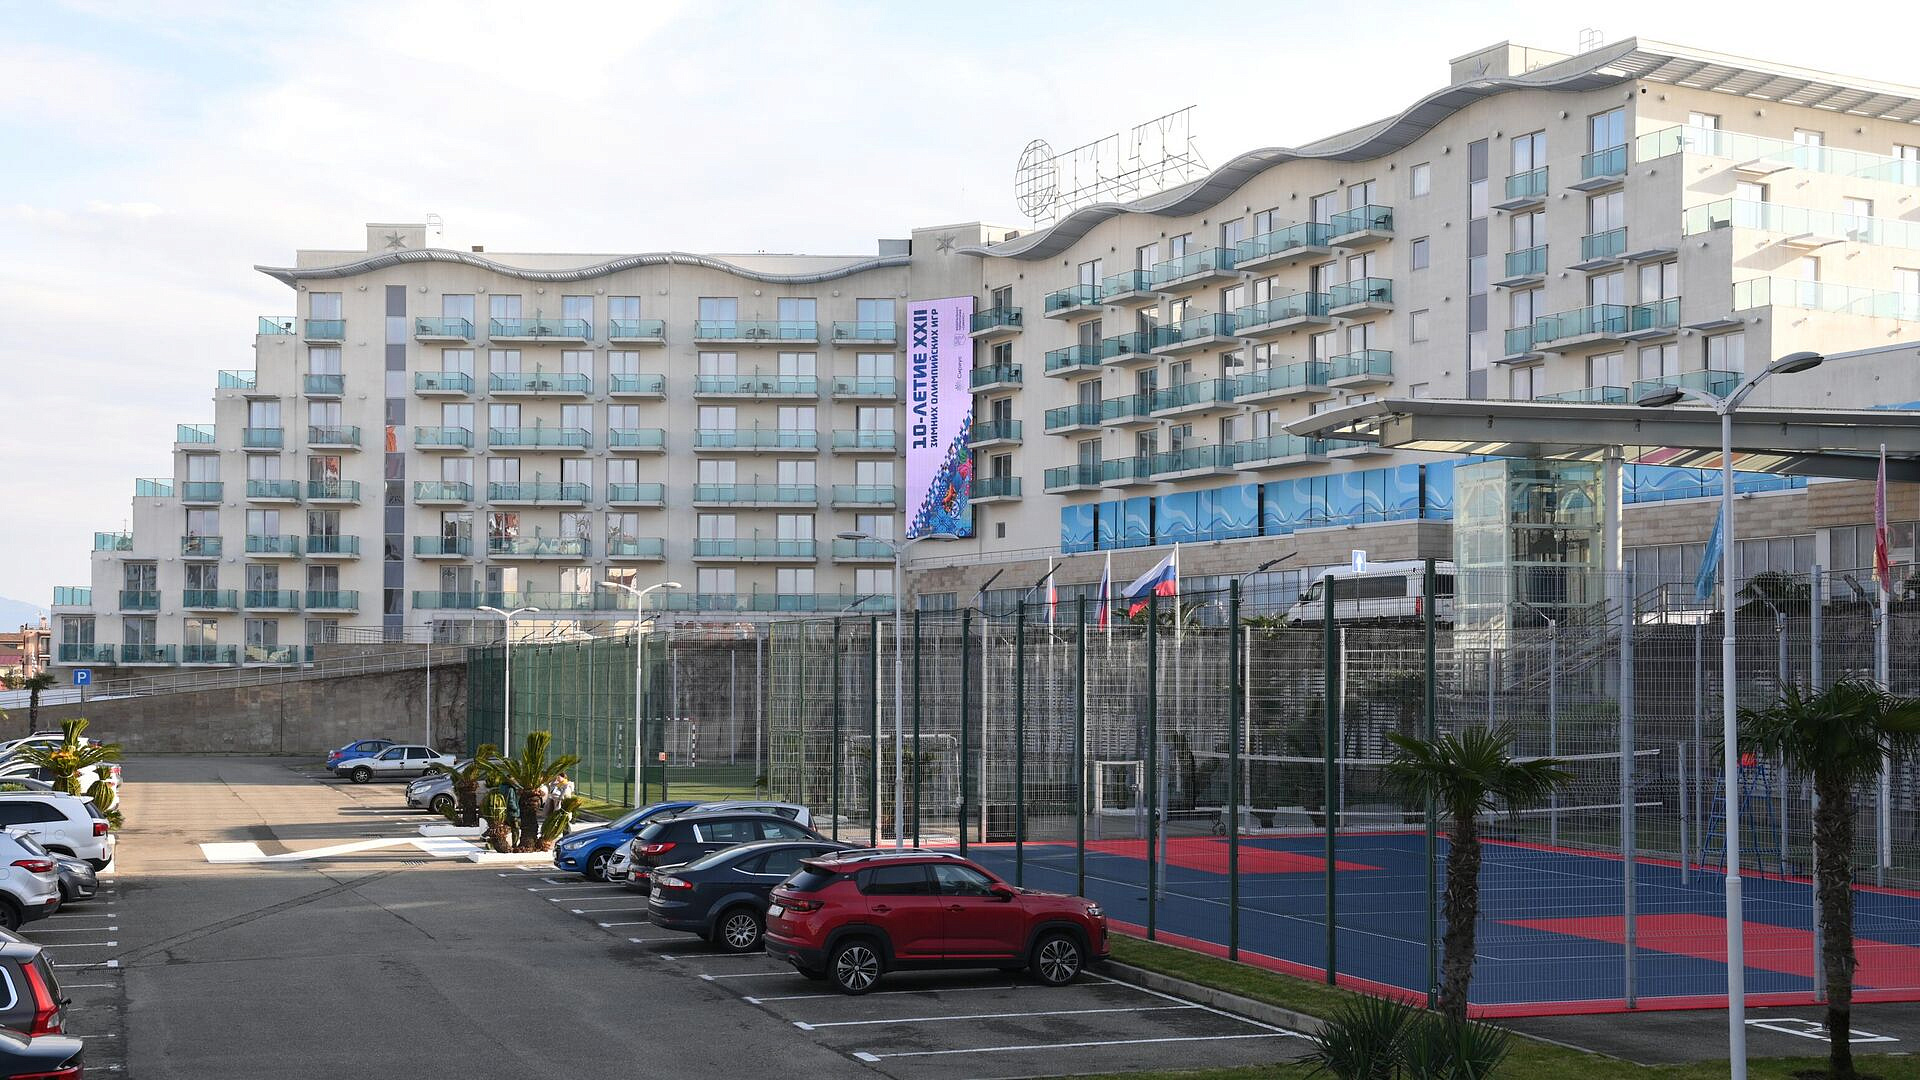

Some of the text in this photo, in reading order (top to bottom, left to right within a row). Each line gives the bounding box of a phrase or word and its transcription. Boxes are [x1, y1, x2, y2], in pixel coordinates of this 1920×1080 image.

[912, 310, 927, 449] 10-ЛЕТИЕ XXII
[929, 330, 938, 404] ОЛИМПИЙСКИХ
[930, 407, 938, 448] ЗИМНИХ
[77, 672, 87, 684] P
